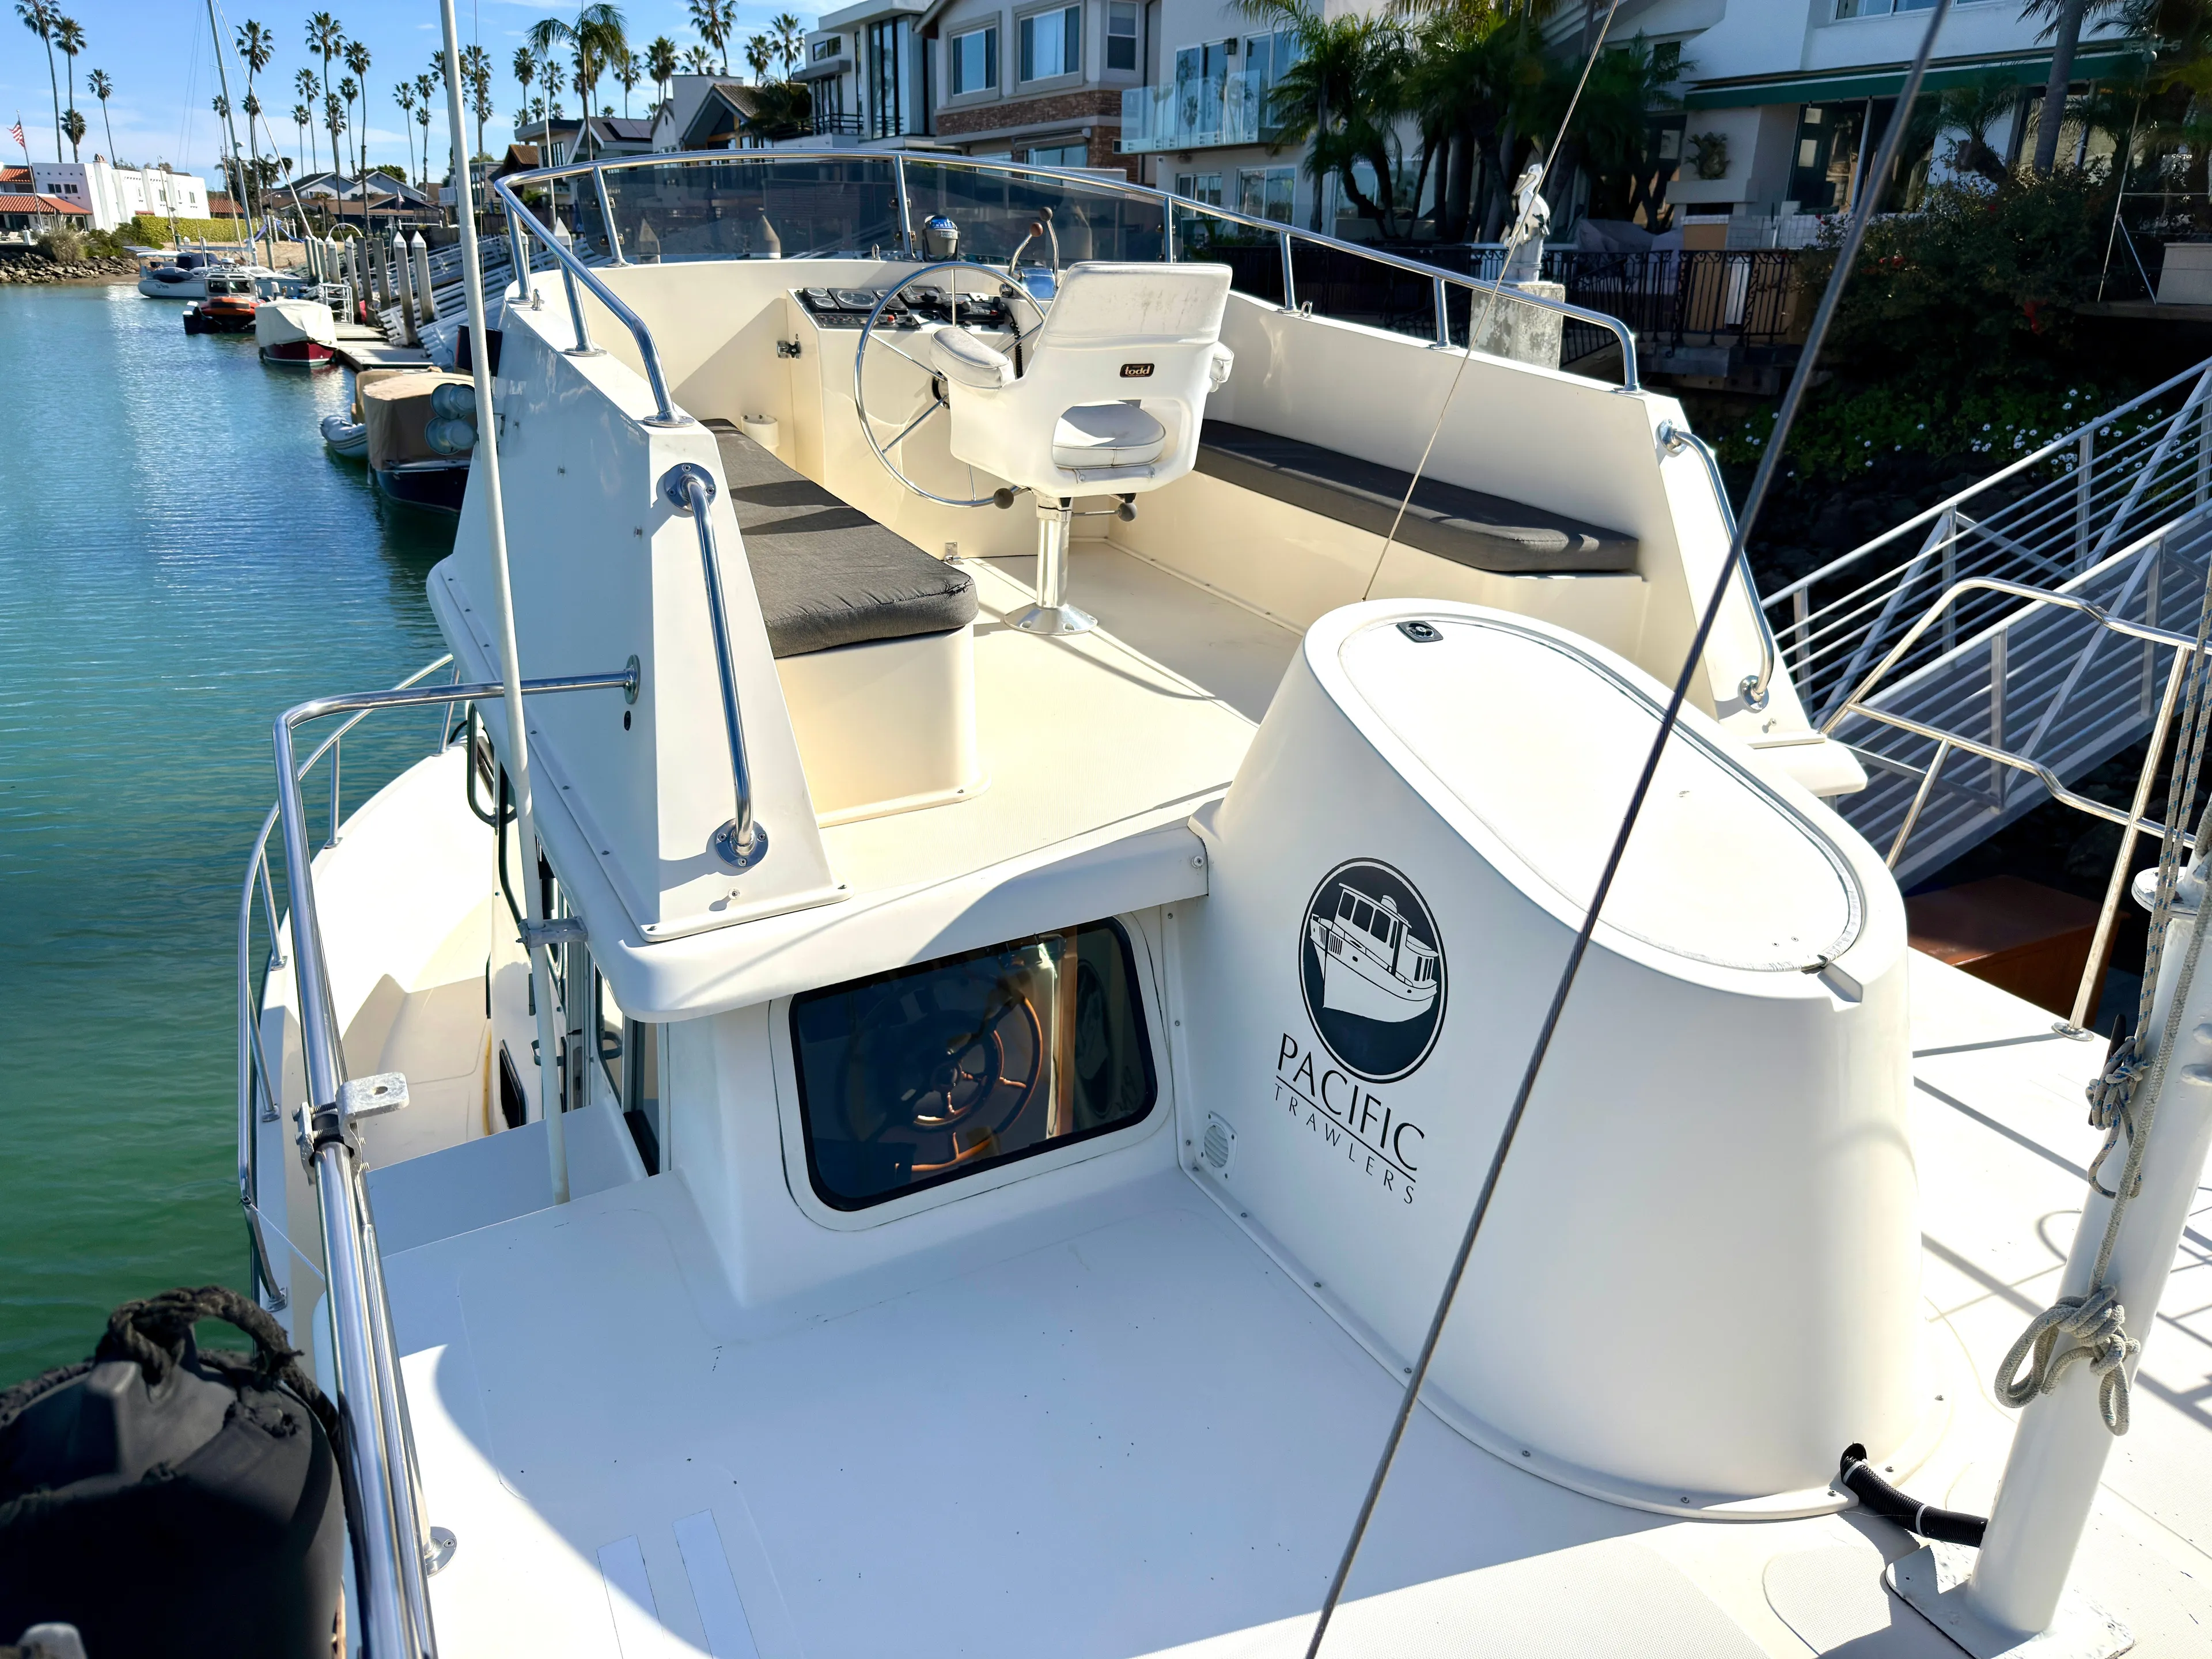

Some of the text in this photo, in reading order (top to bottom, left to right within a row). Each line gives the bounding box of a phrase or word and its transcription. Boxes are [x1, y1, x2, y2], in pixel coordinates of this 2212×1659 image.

[1124, 365, 1151, 375] todd
[1275, 1083, 1414, 1204] TRAWLERS
[1277, 1032, 1425, 1171] PACIFIC
